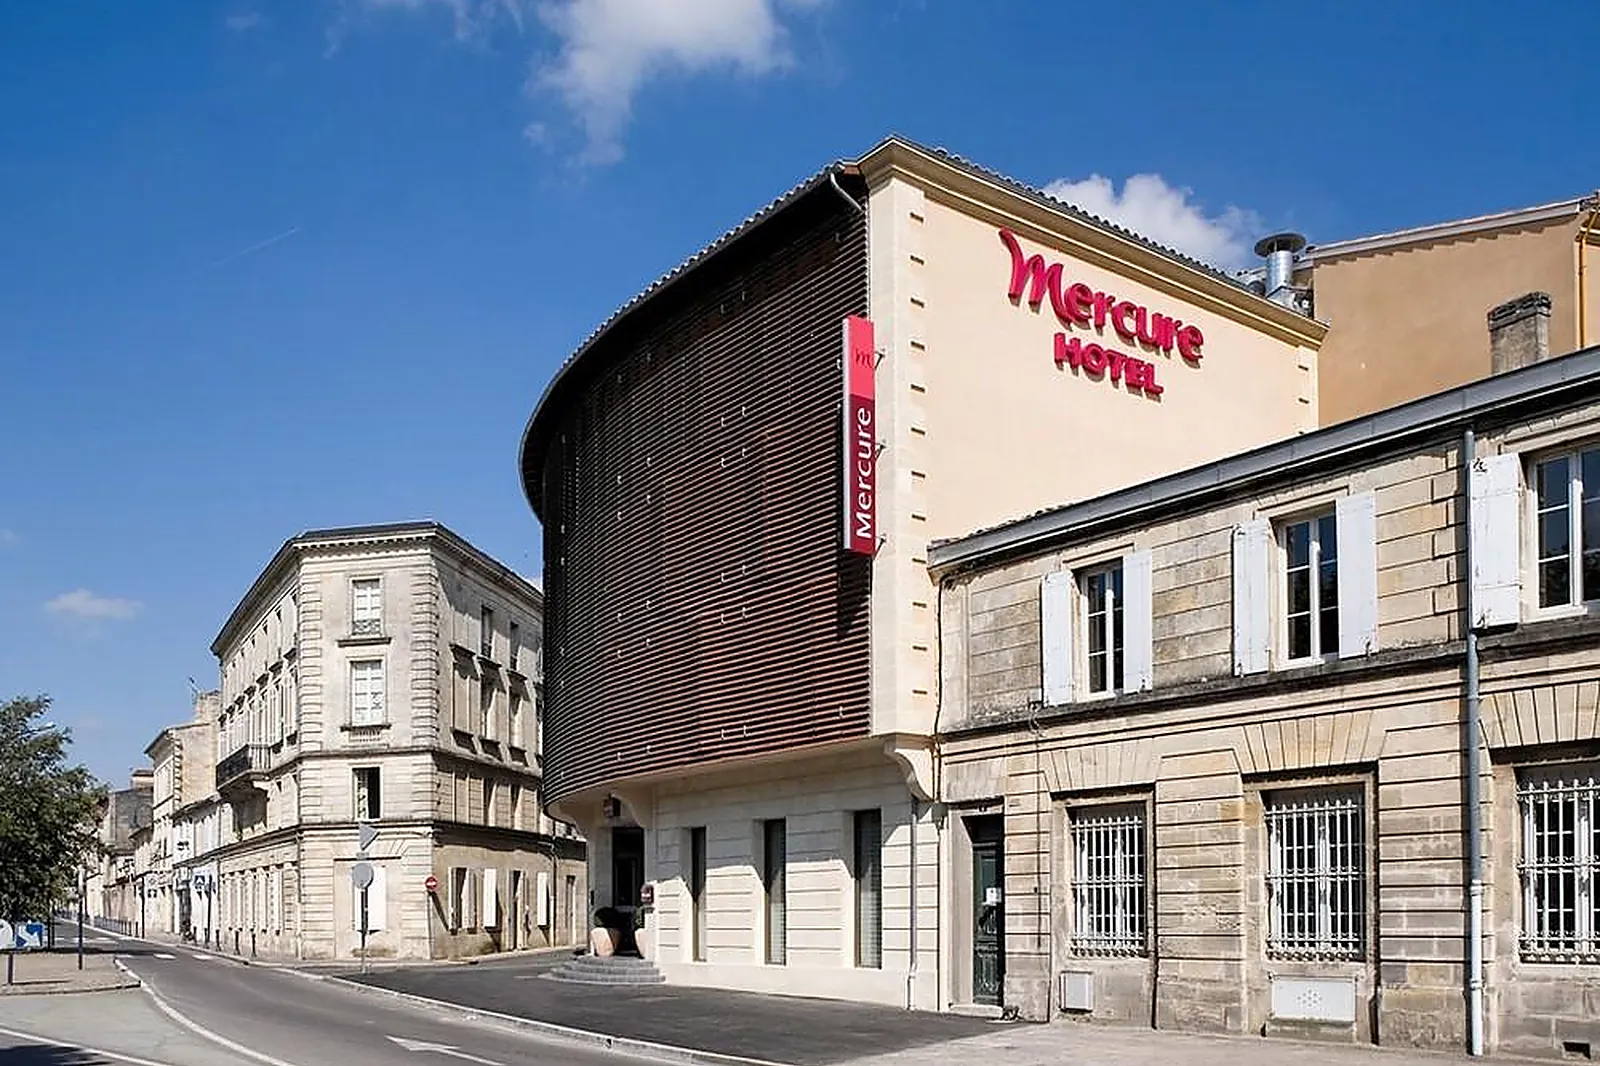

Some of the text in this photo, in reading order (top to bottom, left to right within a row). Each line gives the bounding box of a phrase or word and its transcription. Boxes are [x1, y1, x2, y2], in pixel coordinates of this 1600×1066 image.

[998, 227, 1204, 362] Mercure
[1054, 332, 1164, 396] HOTEL
[856, 407, 872, 539] Mercure
